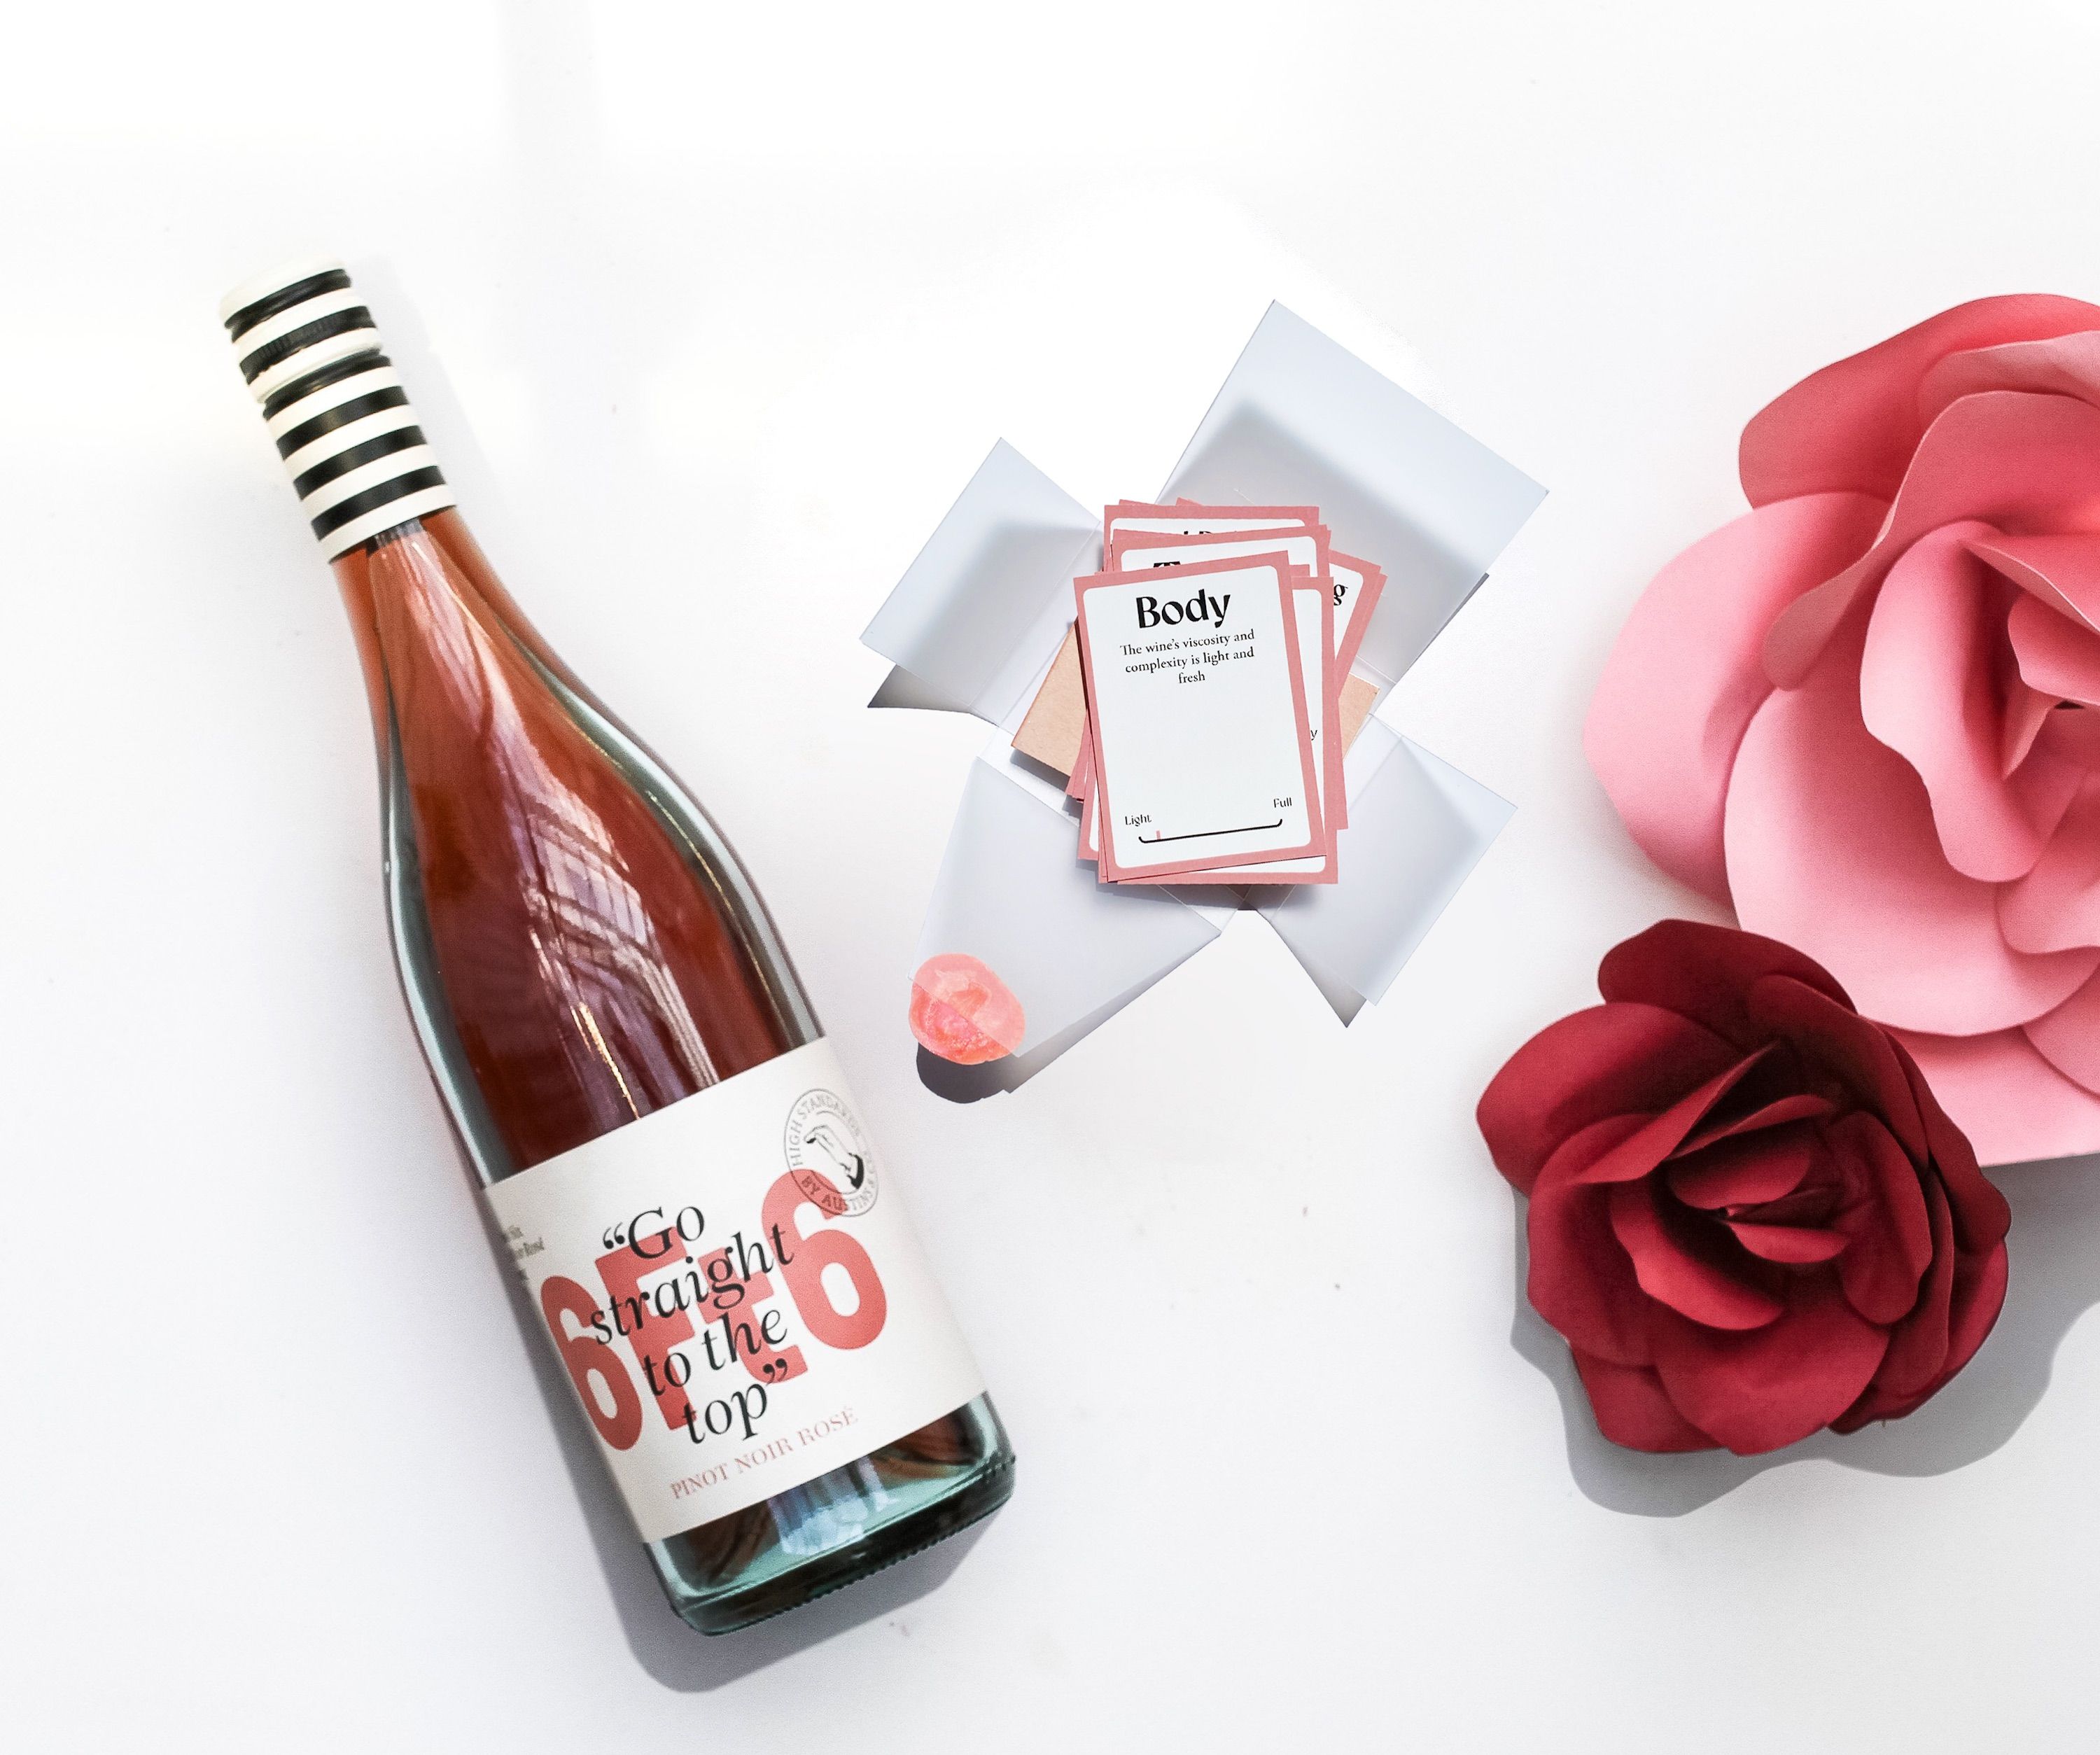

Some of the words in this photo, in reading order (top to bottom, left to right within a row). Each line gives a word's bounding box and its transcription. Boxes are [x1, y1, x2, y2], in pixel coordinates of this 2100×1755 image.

[1136, 589, 1231, 628] Body
[1120, 643, 1142, 655] The
[1146, 638, 1180, 652] wine’s
[1183, 634, 1231, 648] viscosity
[1234, 629, 1255, 641] and
[1126, 657, 1188, 673] complexity
[1191, 655, 1200, 665] is
[1203, 650, 1230, 666] light
[1233, 646, 1255, 659] and
[1178, 671, 1205, 684] fresh
[1124, 814, 1152, 827] Light
[1273, 797, 1292, 808] Full
[788, 1119, 804, 1167] HIGH
[801, 1175, 822, 1195] BY
[603, 1205, 705, 1259] “Go
[590, 1222, 794, 1345] straight
[642, 1352, 691, 1397] to
[701, 1309, 788, 1370] the
[682, 1357, 788, 1444] top”
[670, 1462, 729, 1499] PINOT
[734, 1437, 794, 1474] NOIR
[796, 1406, 859, 1446] ROSÉ
